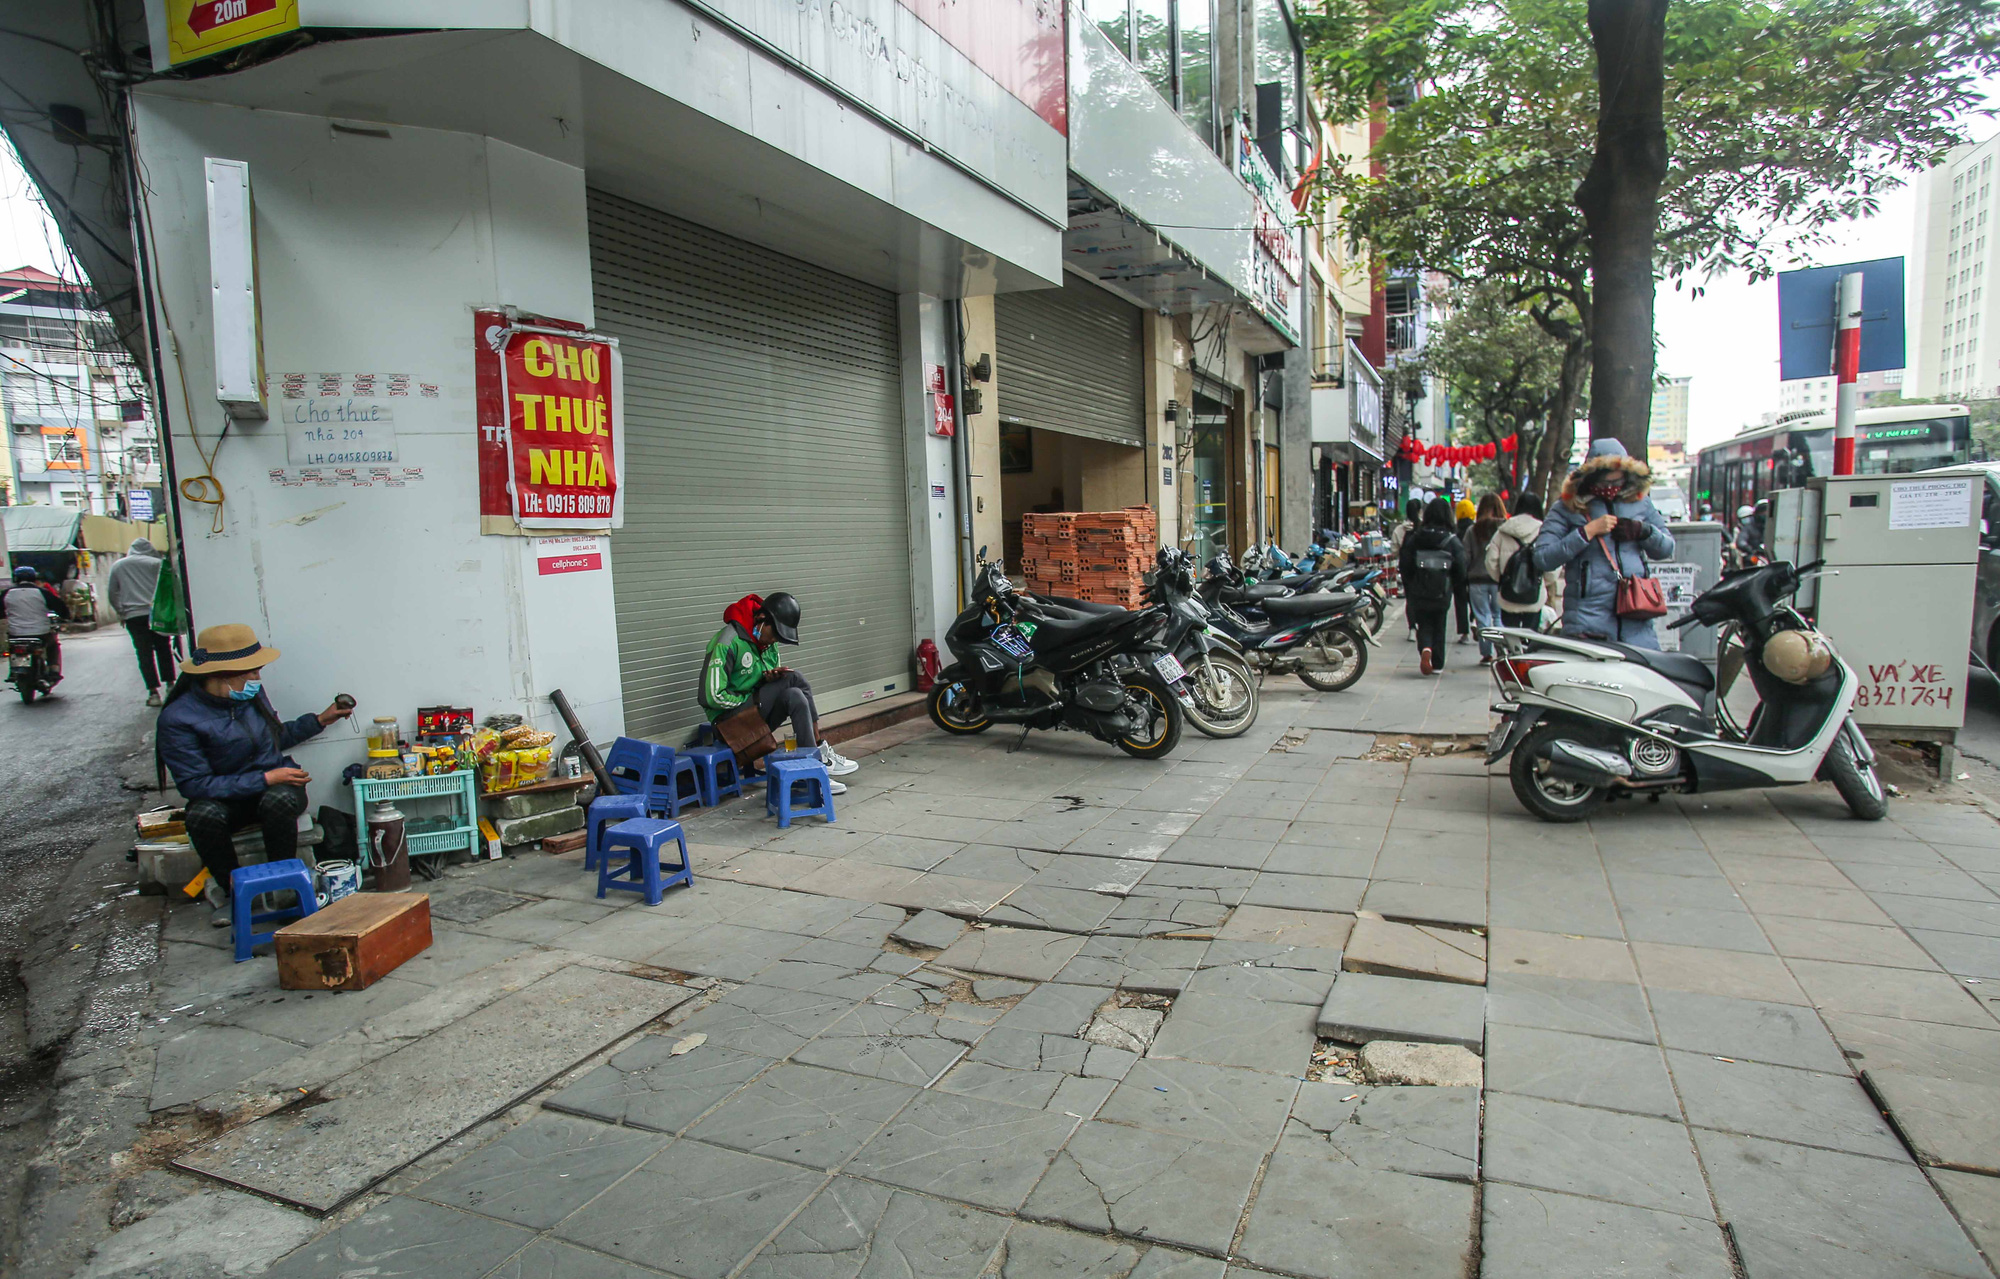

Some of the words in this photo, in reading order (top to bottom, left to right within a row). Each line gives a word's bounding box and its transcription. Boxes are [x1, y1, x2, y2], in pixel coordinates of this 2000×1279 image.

[214, 0, 247, 24] 20m
[523, 339, 600, 385] CHO
[294, 398, 330, 424] Cho
[515, 393, 609, 438] THUÊ
[937, 406, 953, 423] 204
[308, 453, 324, 465] LH
[528, 444, 608, 487] NHÀ
[546, 494, 576, 514] 0915
[578, 495, 594, 514] 809
[596, 495, 611, 514] 878
[1908, 664, 1946, 683] XE
[1851, 683, 1953, 709] 8321764
